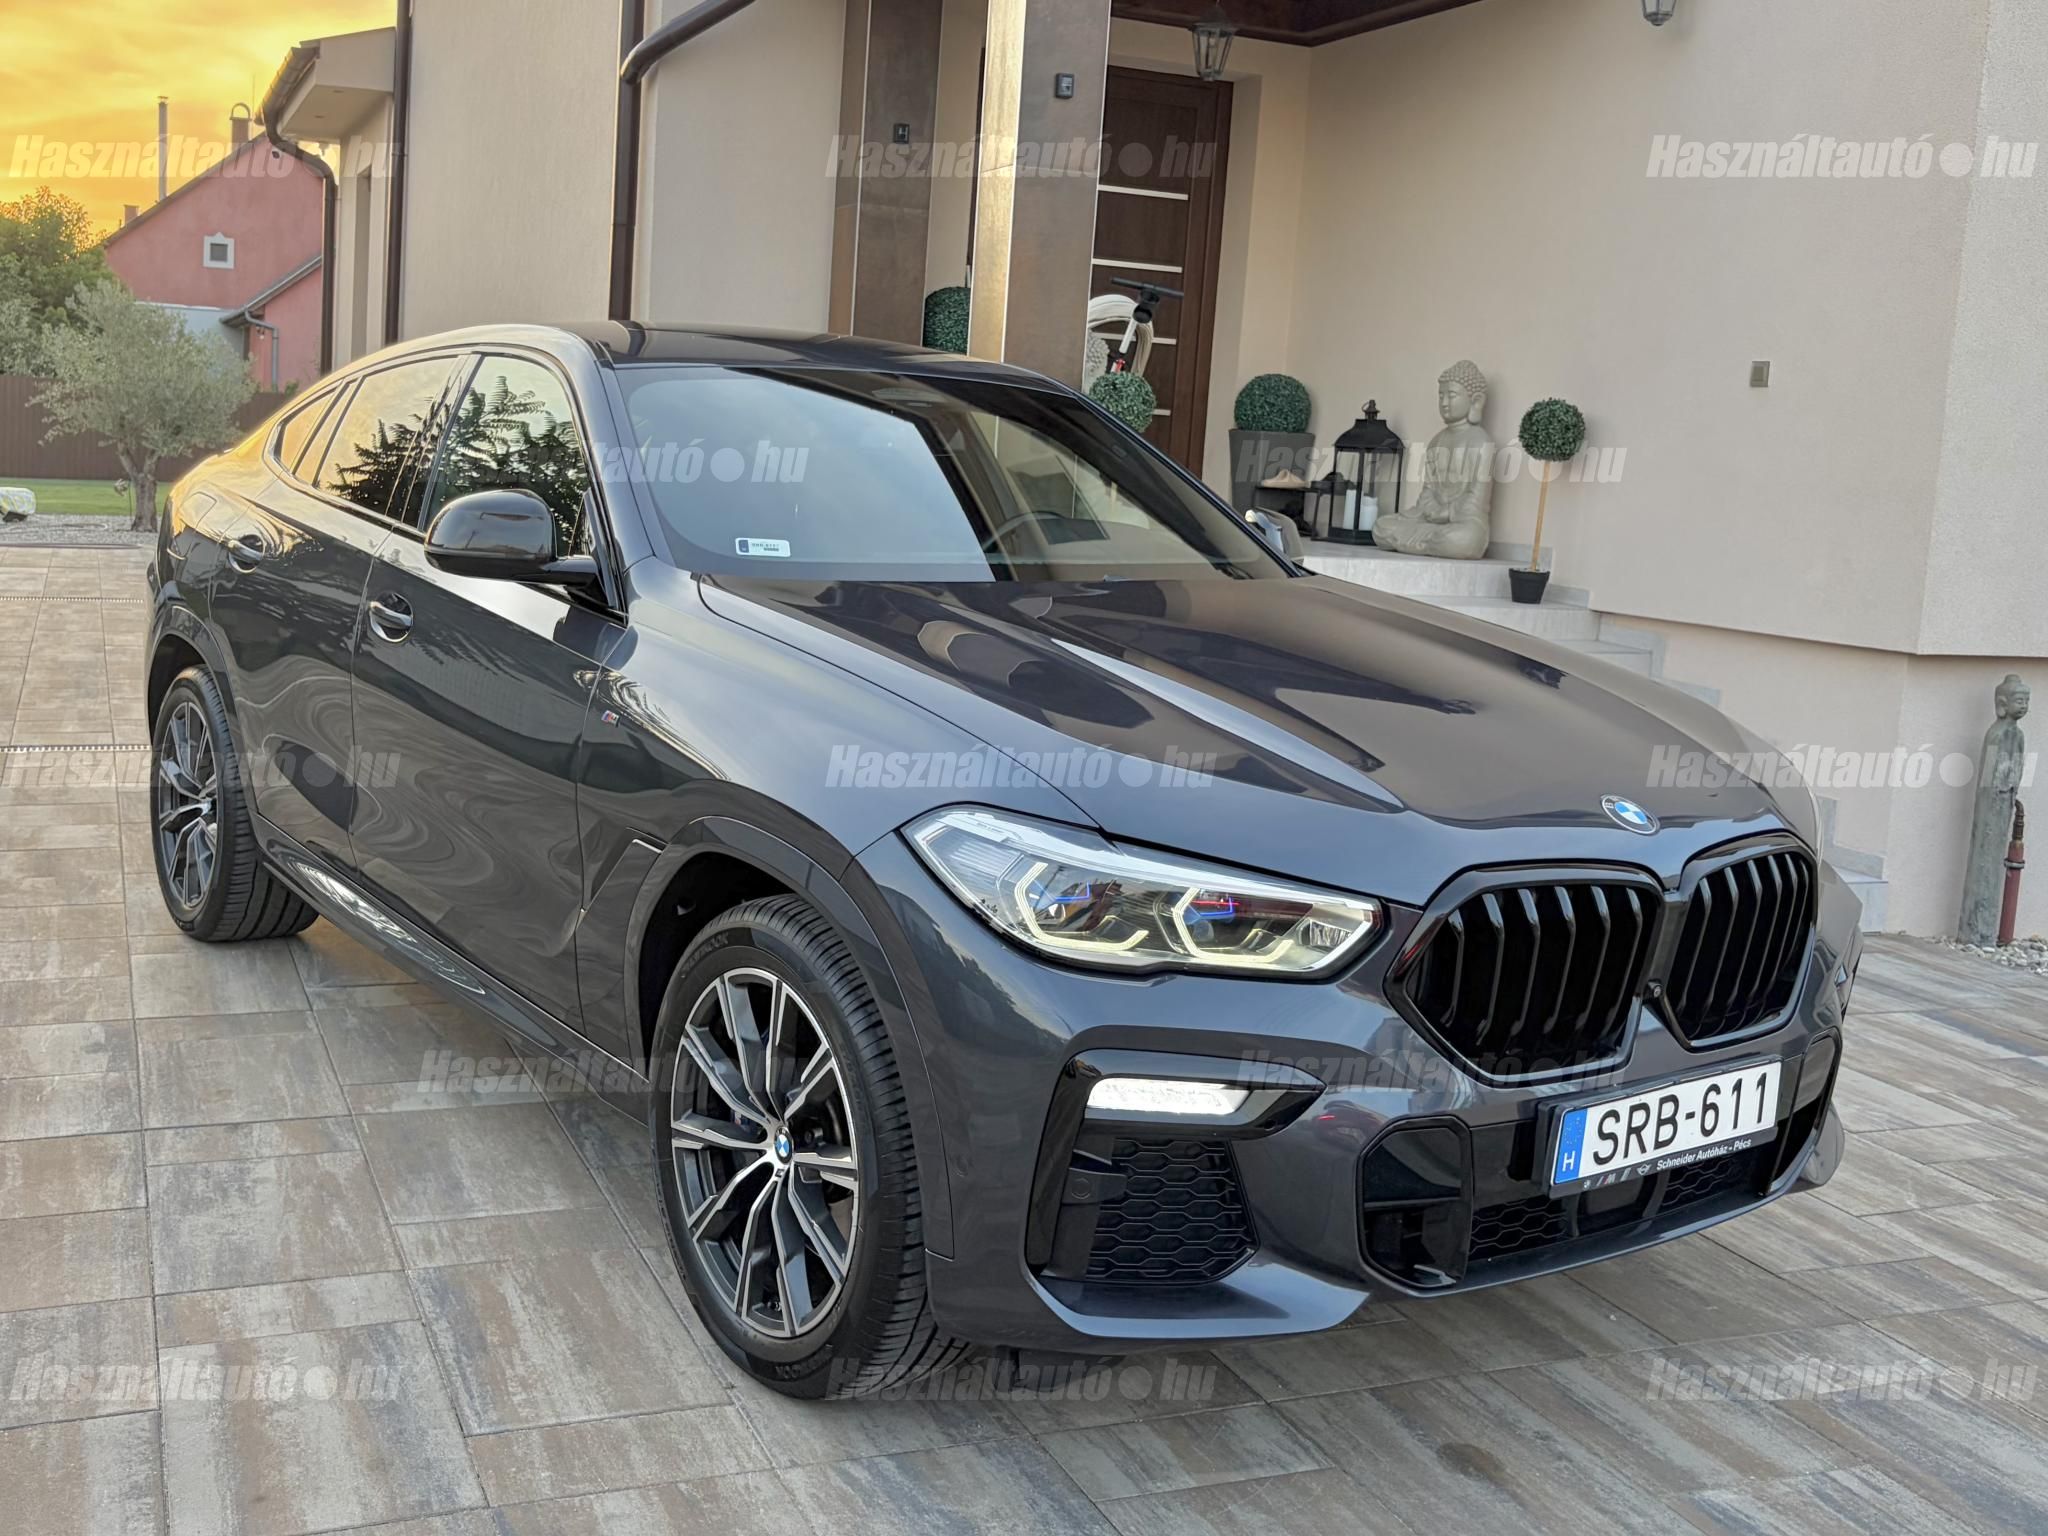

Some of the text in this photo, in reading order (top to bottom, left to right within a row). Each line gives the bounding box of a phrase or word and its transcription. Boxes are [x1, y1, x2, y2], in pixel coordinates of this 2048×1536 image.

[1593, 1072, 1767, 1165] SRB-611
[1656, 1153, 1696, 1171] Schneider
[1696, 1145, 1728, 1162] Autóház
